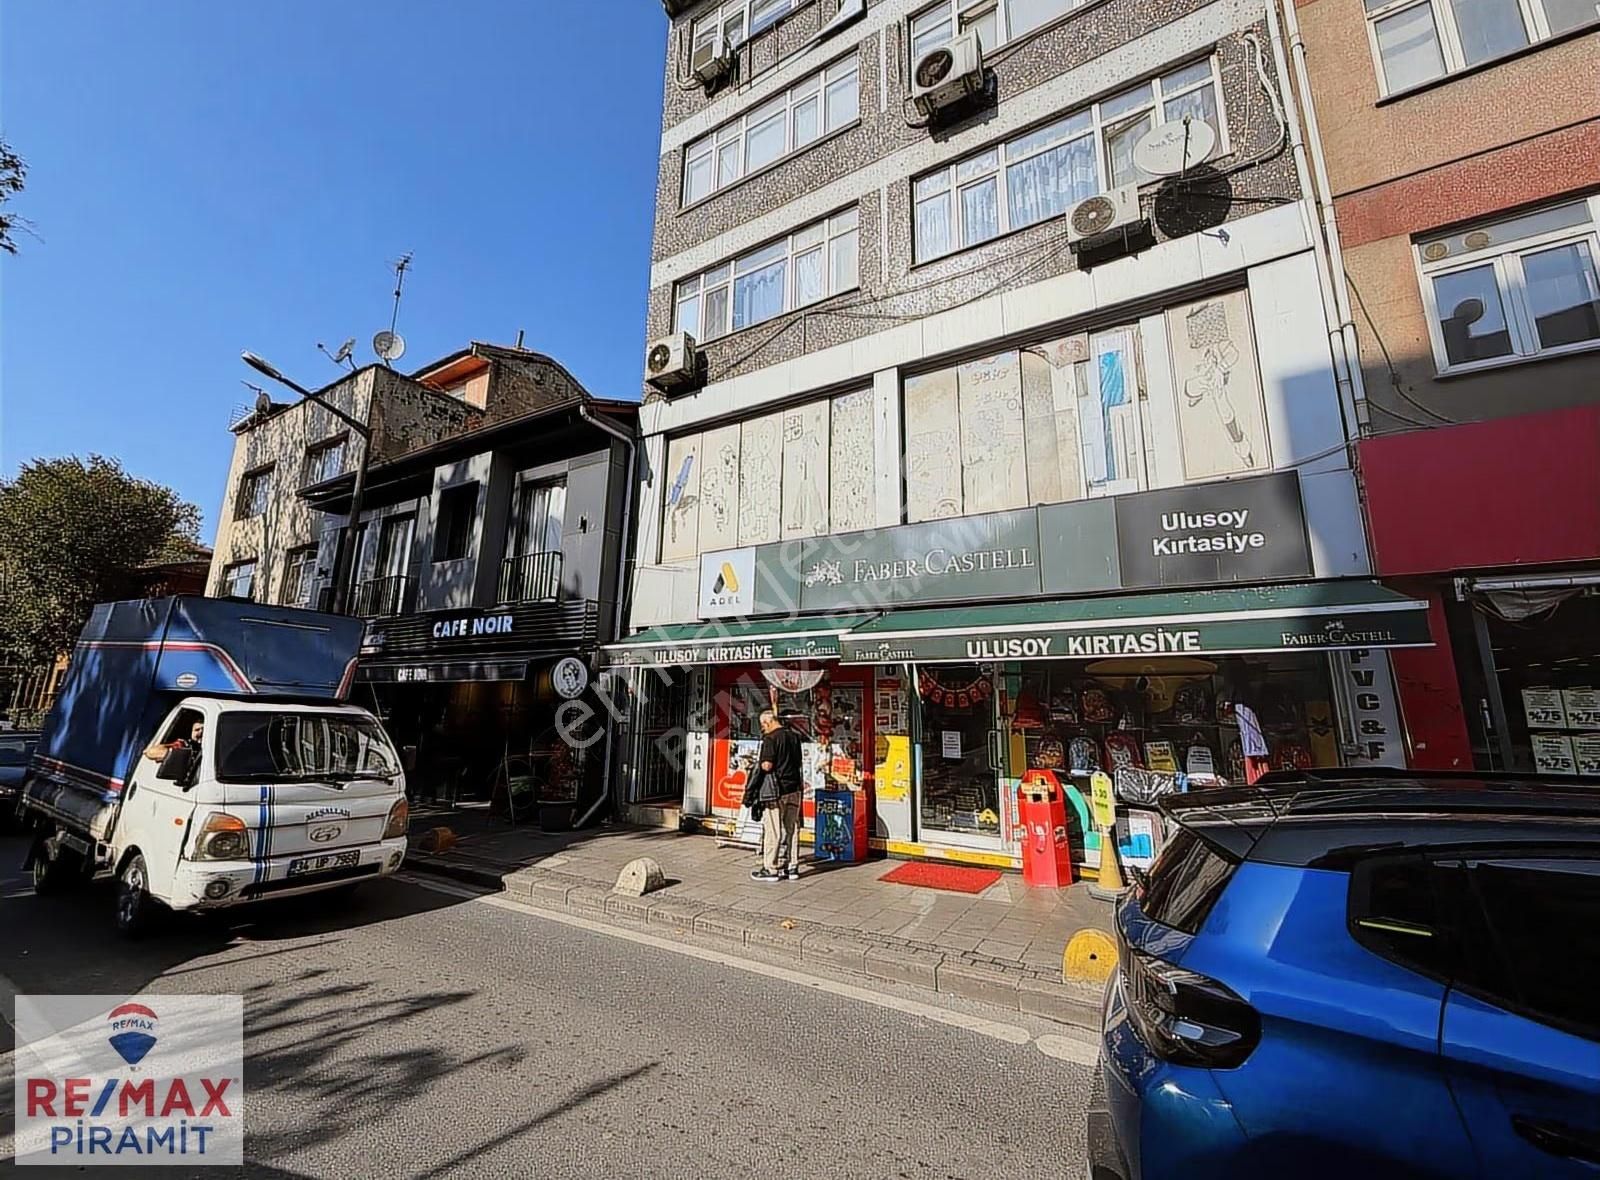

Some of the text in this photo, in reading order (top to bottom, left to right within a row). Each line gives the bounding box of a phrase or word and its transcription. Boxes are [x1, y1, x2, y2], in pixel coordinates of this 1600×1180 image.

[1161, 510, 1249, 531] Ulusoy
[1152, 532, 1265, 556] Kırtasiye
[854, 548, 1035, 583] FABER-CASTELL
[710, 595, 741, 606] ADEL
[433, 615, 514, 639] CAFE NOIR
[655, 648, 700, 664] ULUSOY
[707, 642, 773, 662] KIRTASİYE
[967, 628, 1201, 659] ULUSOY KIRTASİYE
